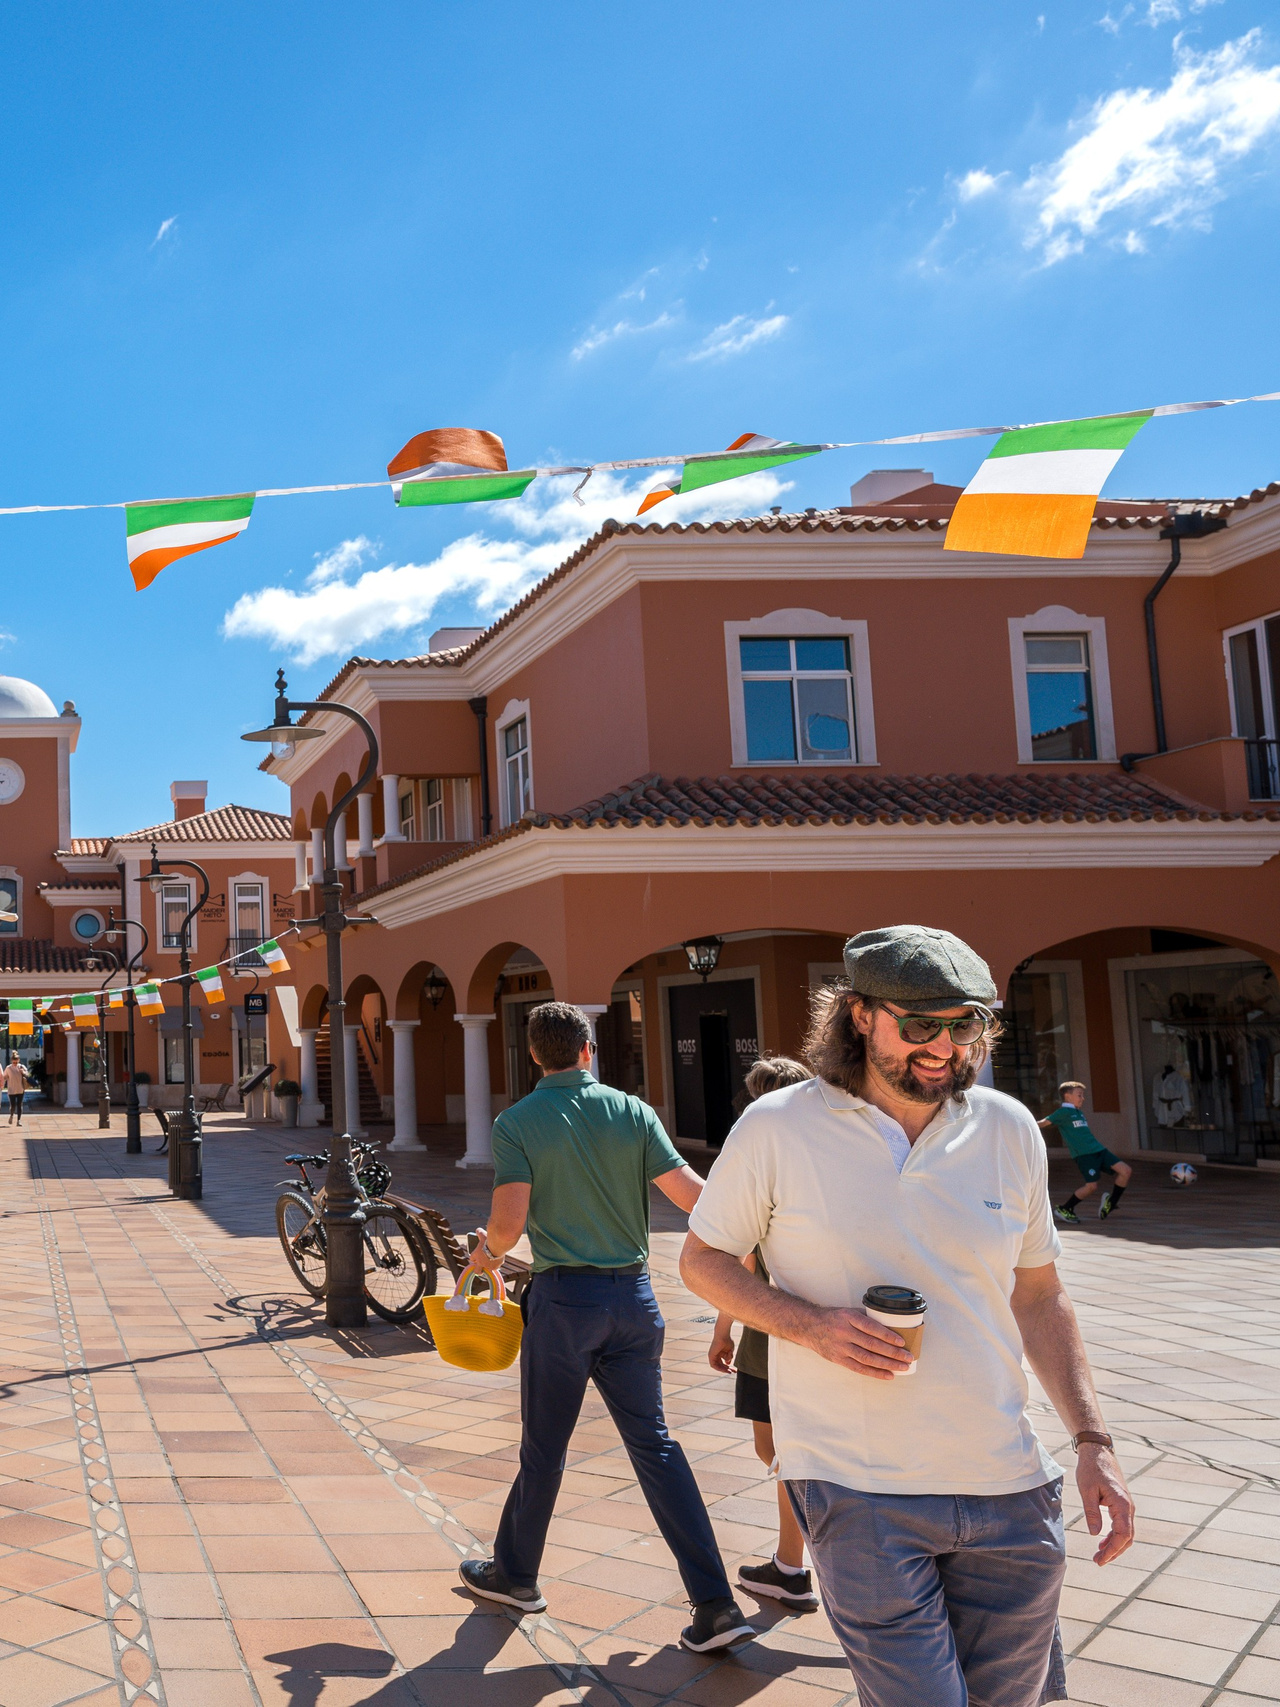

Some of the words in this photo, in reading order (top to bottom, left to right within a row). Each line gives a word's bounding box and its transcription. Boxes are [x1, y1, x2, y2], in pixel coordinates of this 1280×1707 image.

[248, 999, 263, 1007] MB
[677, 1039, 696, 1053] BOSS
[735, 1038, 758, 1053] BOSS
